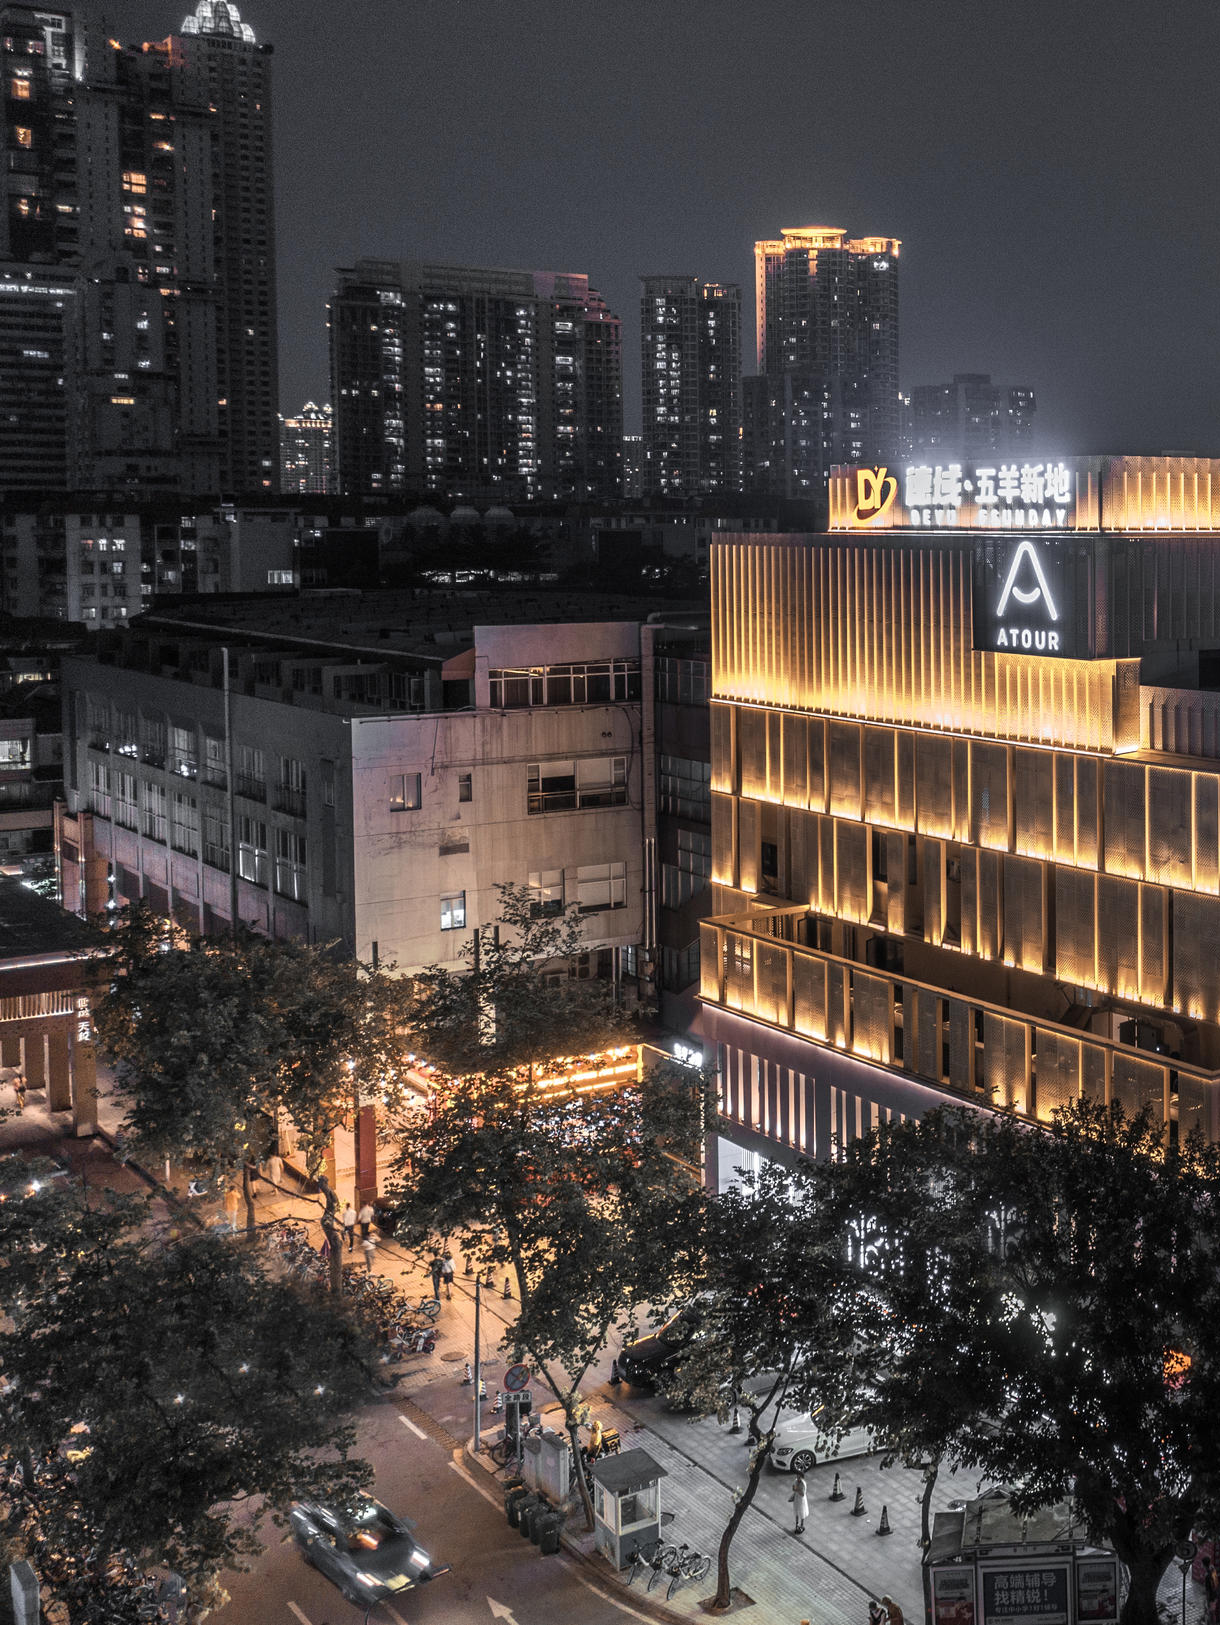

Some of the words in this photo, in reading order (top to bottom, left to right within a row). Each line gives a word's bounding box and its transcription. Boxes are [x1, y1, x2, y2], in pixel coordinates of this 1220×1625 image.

[997, 628, 1060, 651] ATOUR
[994, 1572, 1057, 1590] 高端辅导
